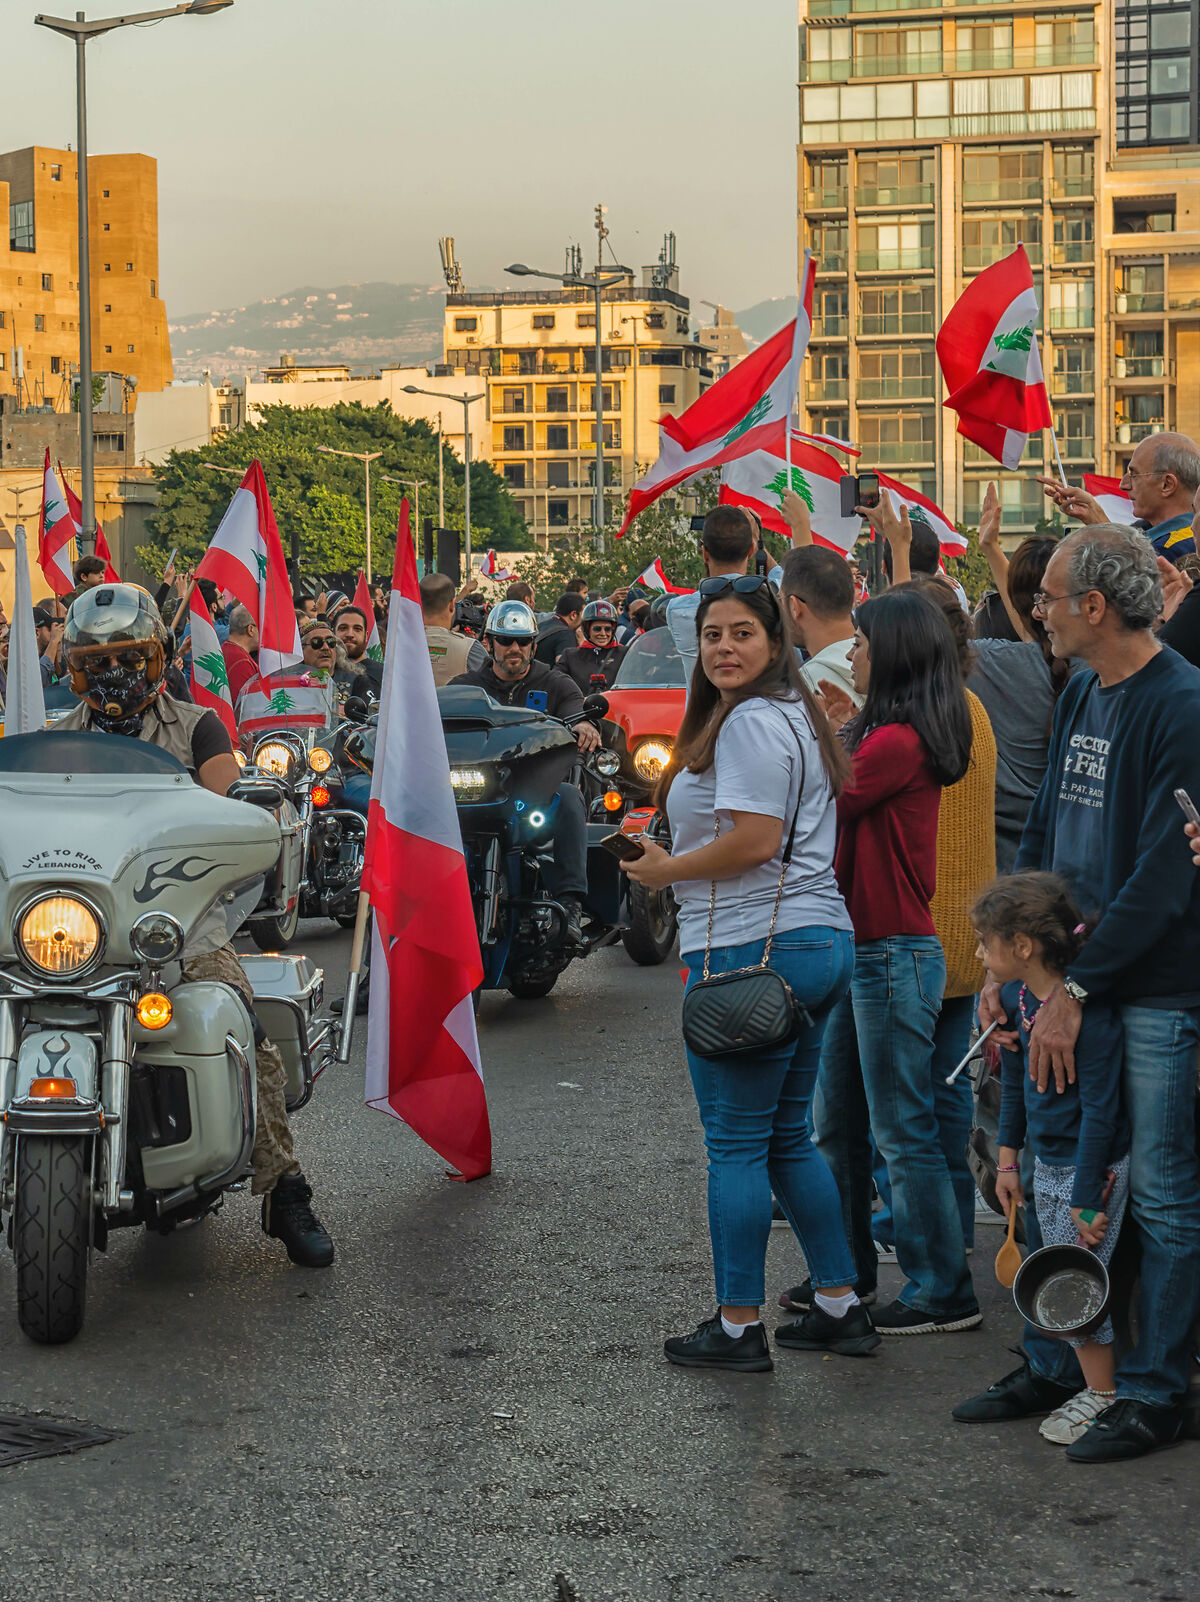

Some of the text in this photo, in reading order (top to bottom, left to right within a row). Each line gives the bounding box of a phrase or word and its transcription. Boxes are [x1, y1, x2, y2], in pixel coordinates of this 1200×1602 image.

[22, 851, 50, 869] LIVE
[75, 851, 103, 870] RIDE
[38, 862, 86, 870] LEBANON
